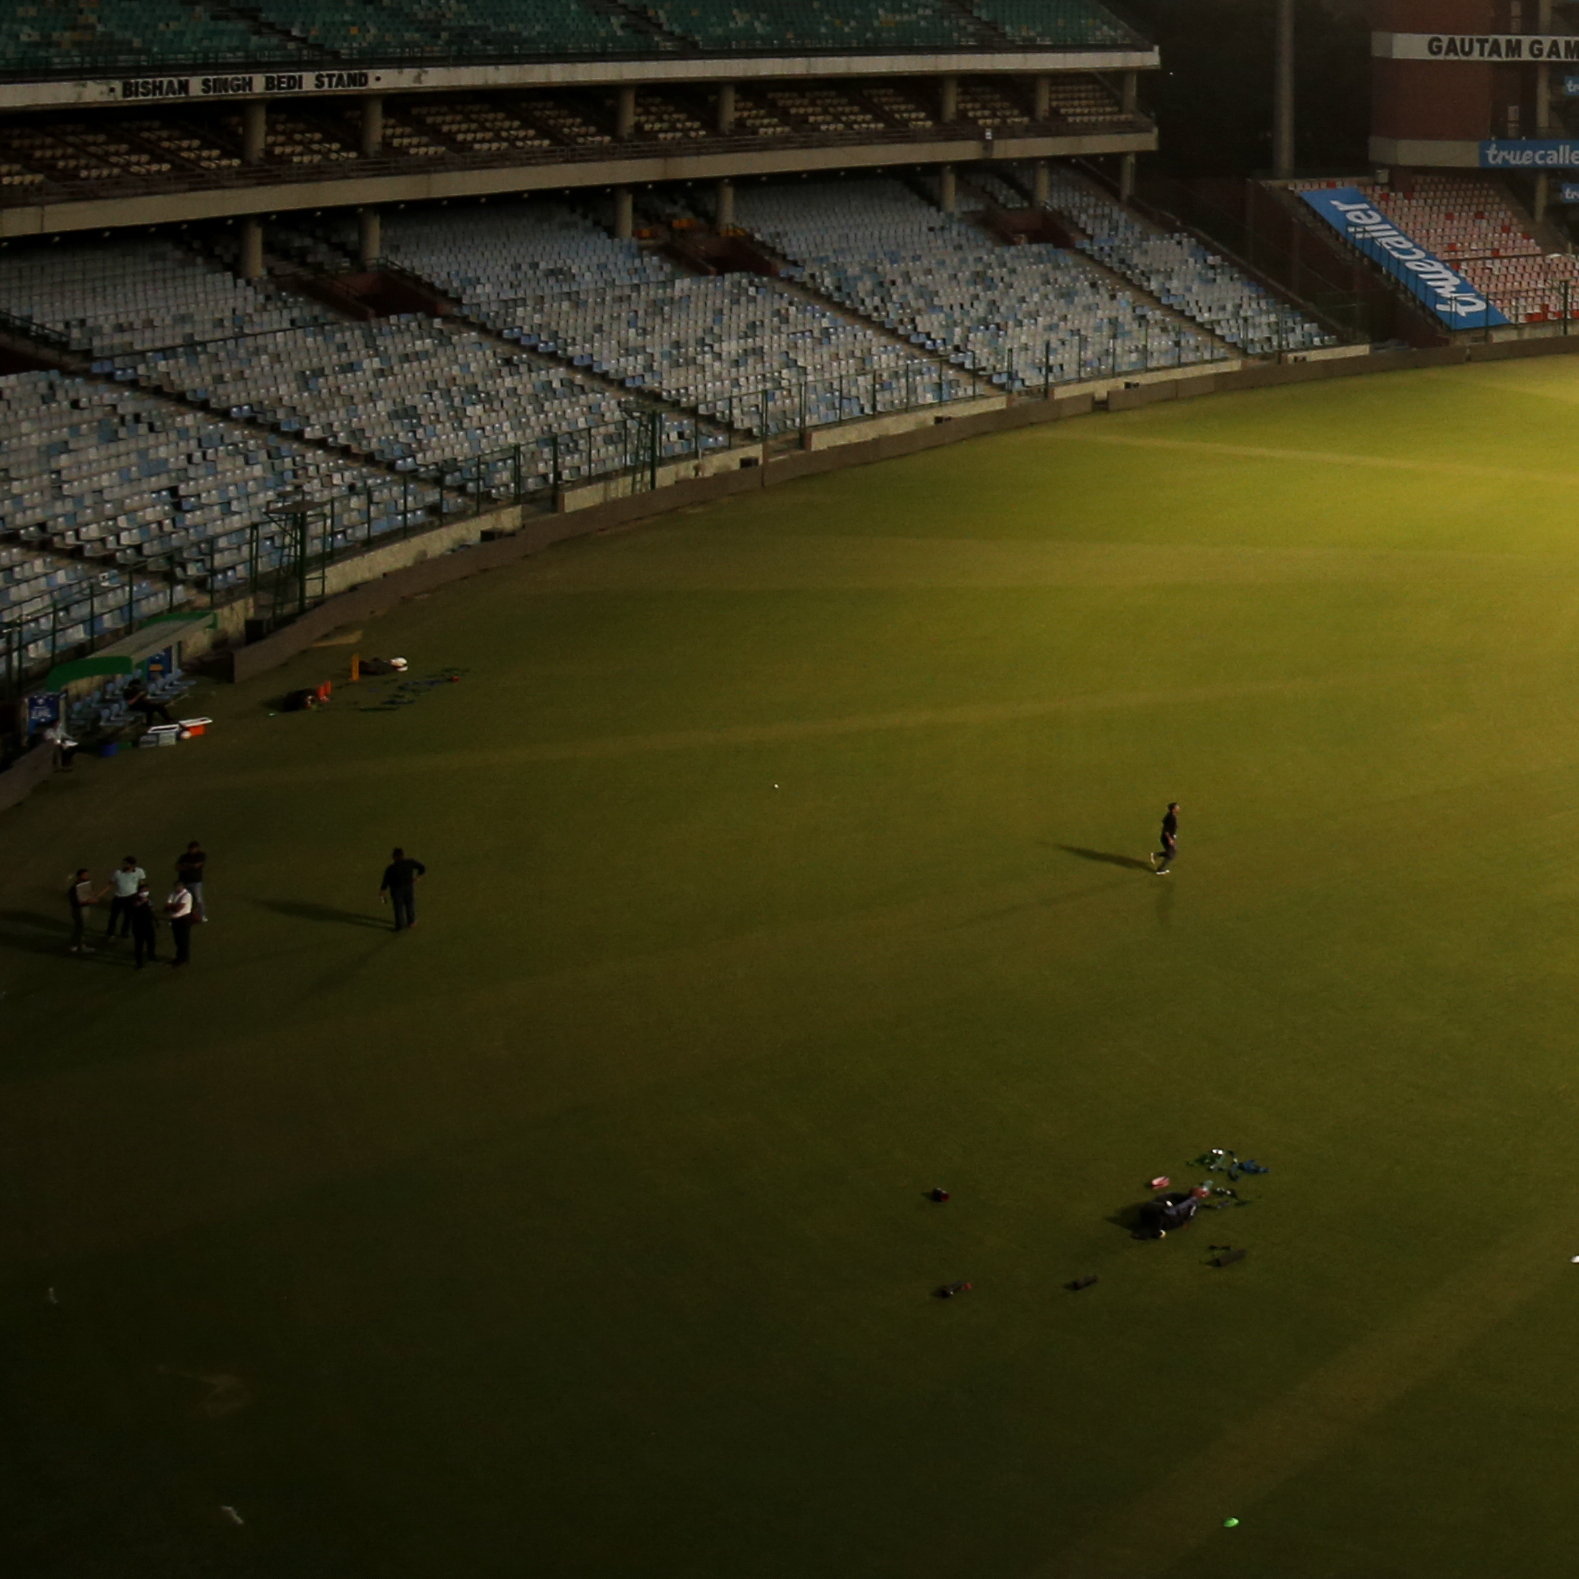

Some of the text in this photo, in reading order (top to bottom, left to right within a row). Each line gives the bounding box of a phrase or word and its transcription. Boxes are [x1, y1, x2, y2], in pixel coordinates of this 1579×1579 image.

[1427, 37, 1522, 58] GAUTAM
[122, 72, 369, 98] BISHAN SINGH BEDI STAND
[1329, 199, 1487, 317] truecaller
